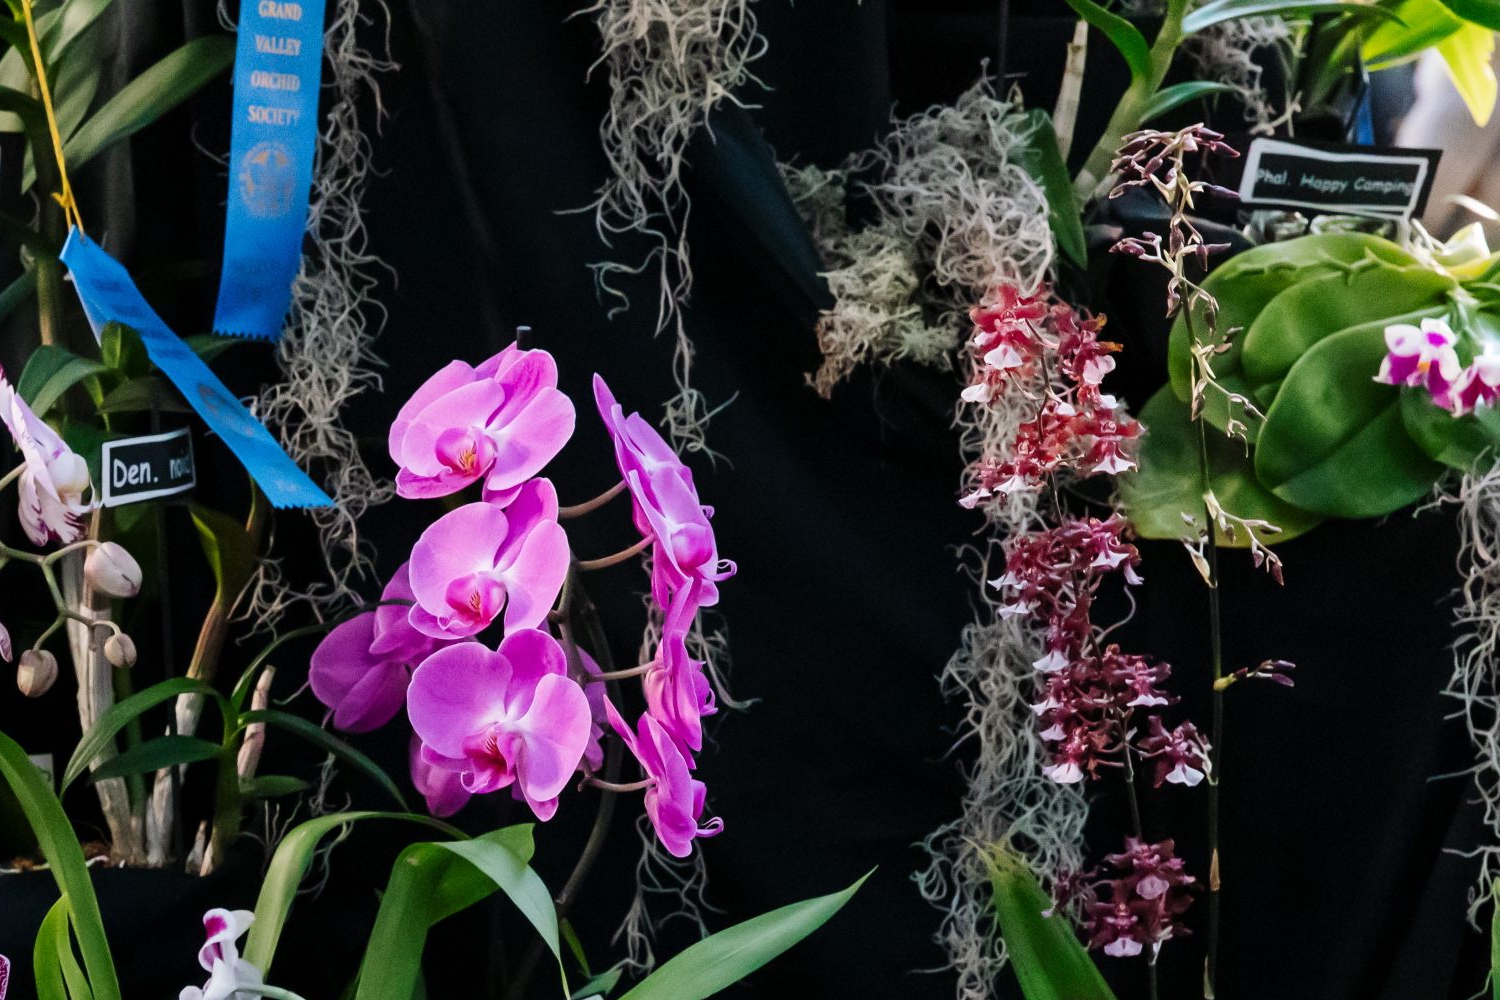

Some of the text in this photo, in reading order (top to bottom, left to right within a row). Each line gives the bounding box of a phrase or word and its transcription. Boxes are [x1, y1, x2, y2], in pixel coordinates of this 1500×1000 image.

[258, 0, 302, 21] GRAND
[255, 34, 301, 56] VALLEY
[250, 69, 301, 92] ORCHID
[247, 104, 299, 127] SOCIETY
[1301, 173, 1348, 193] Happy
[1354, 176, 1415, 197] Camping
[113, 457, 159, 488] Den.
